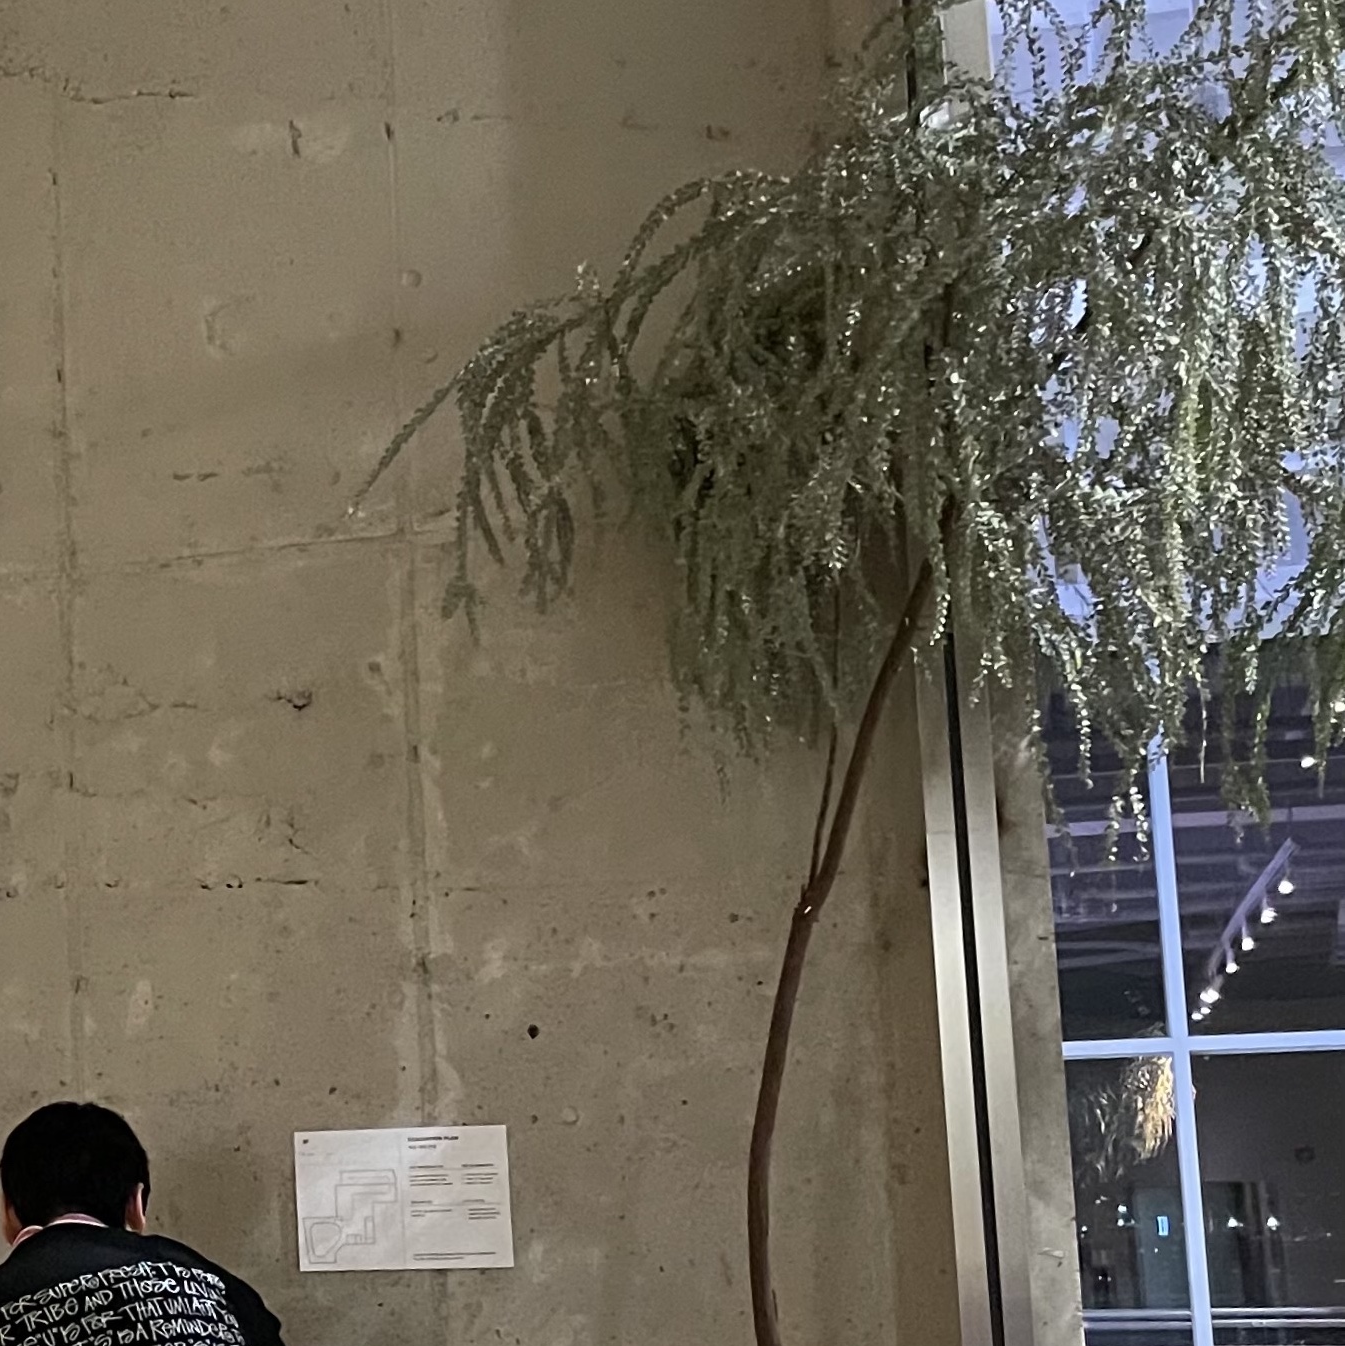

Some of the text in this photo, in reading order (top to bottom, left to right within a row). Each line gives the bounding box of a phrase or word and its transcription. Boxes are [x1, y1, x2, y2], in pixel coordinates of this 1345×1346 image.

[84, 1289, 114, 1312] AND
[111, 1277, 181, 1300] THOSE
[117, 1296, 165, 1322] THAT
